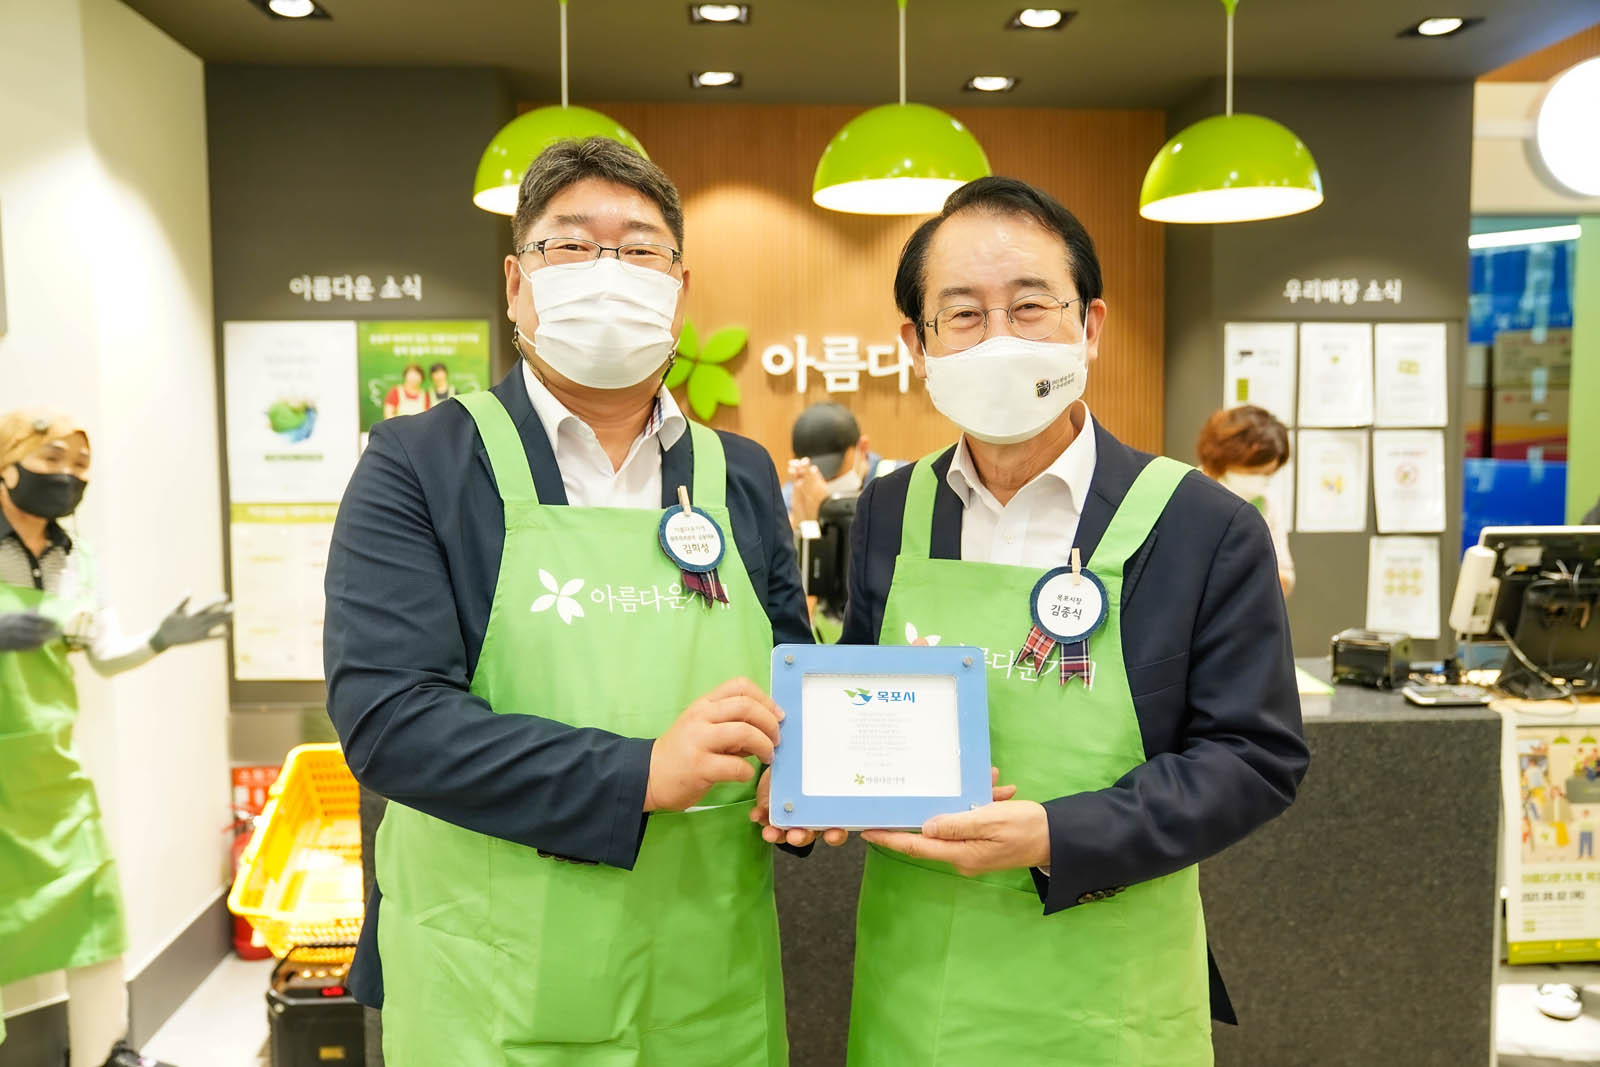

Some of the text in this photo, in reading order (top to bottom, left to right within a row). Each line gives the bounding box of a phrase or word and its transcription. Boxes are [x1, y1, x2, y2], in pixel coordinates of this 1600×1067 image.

[288, 274, 422, 302] 아름다운 소식
[1283, 278, 1402, 305] 우리매장 소식
[590, 583, 731, 614] 아름다운
[1056, 594, 1083, 605] 목포시장
[1050, 604, 1083, 620] 김종식
[876, 690, 916, 704] 목포시
